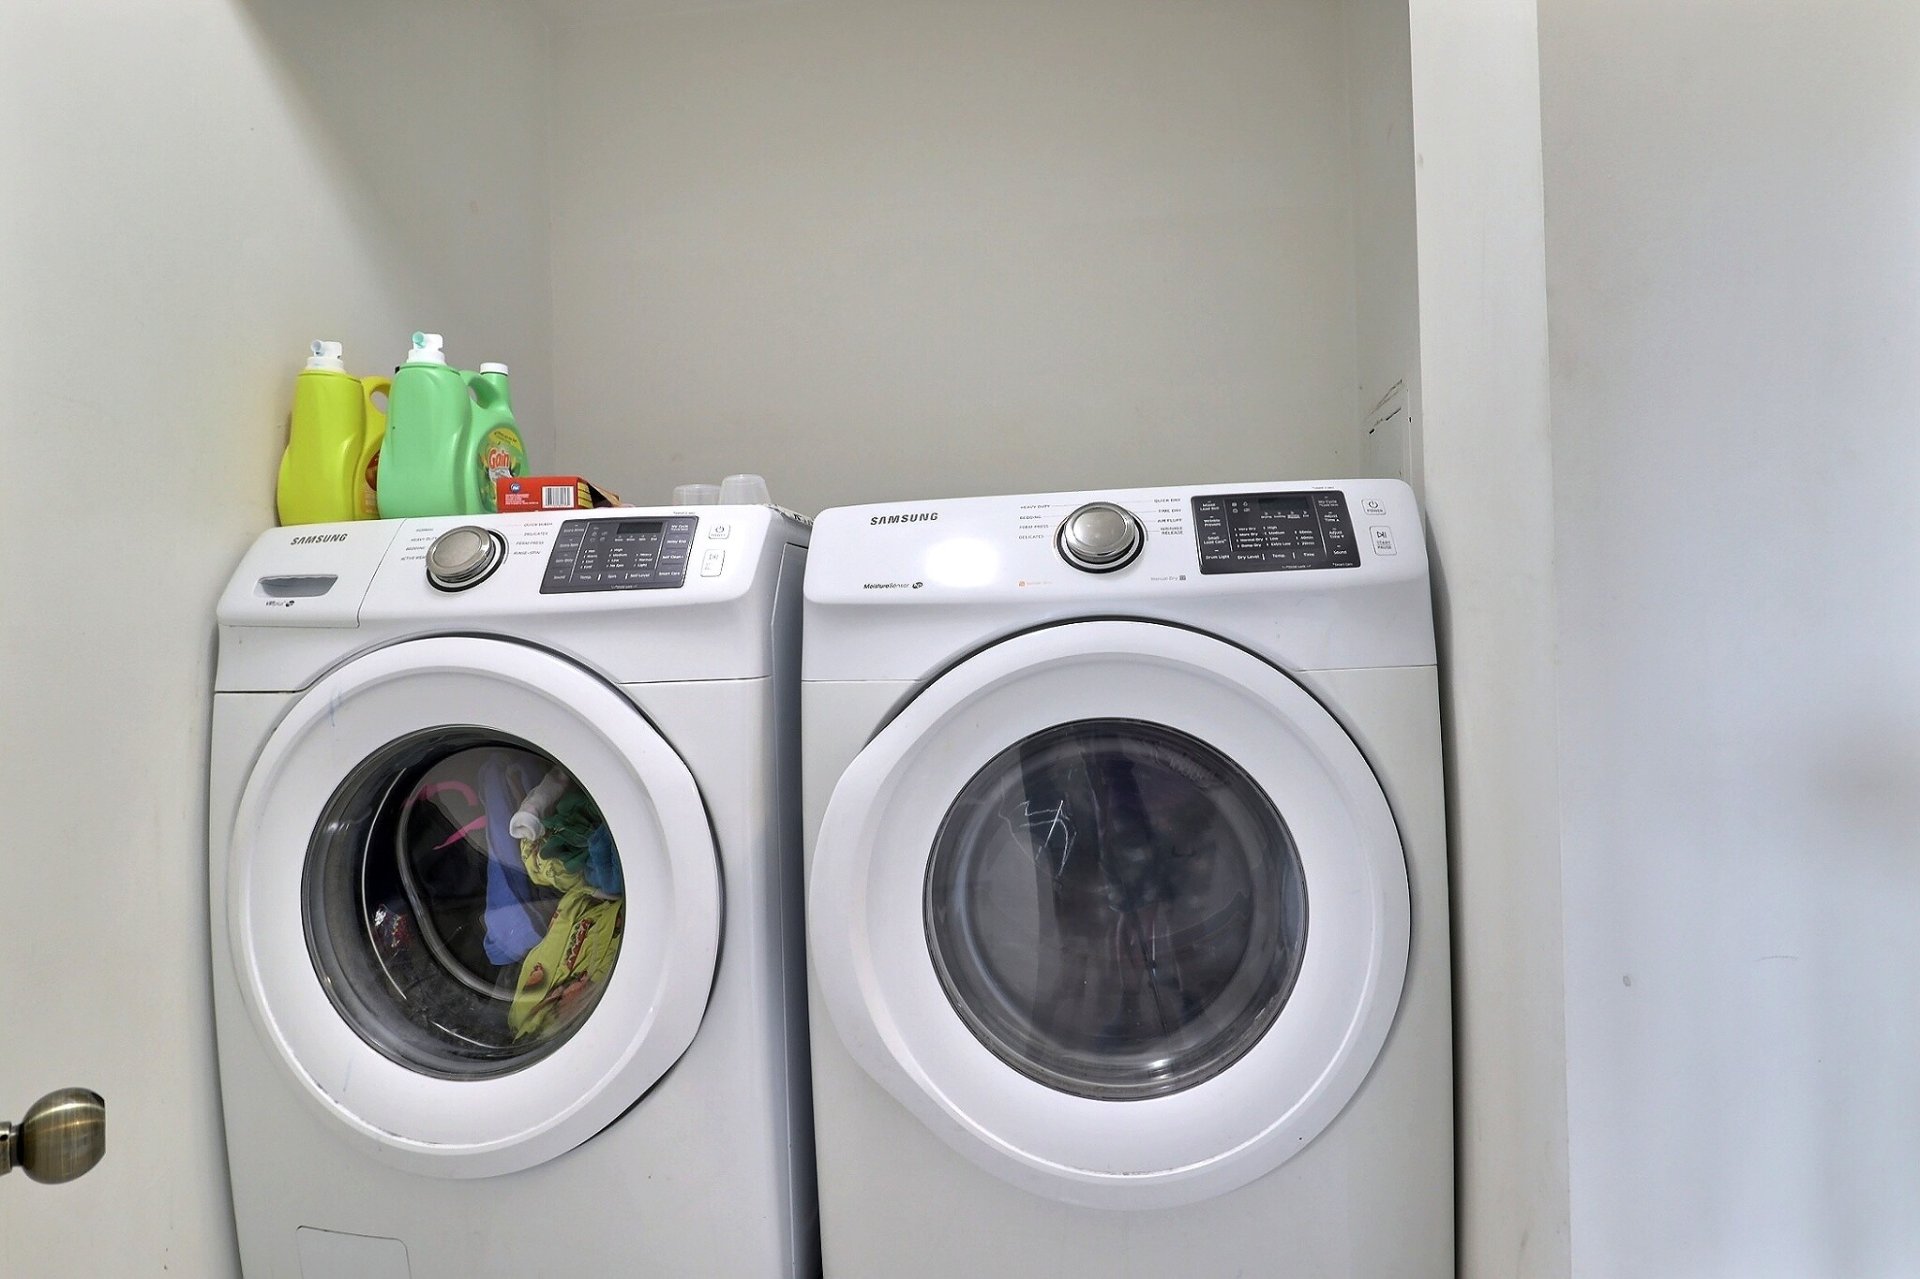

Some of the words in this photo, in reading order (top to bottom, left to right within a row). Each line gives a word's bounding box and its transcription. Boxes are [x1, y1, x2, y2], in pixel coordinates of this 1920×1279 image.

[489, 447, 510, 469] Gain
[870, 512, 938, 526] SAMSUNG
[290, 533, 348, 546] SAMSUNG
